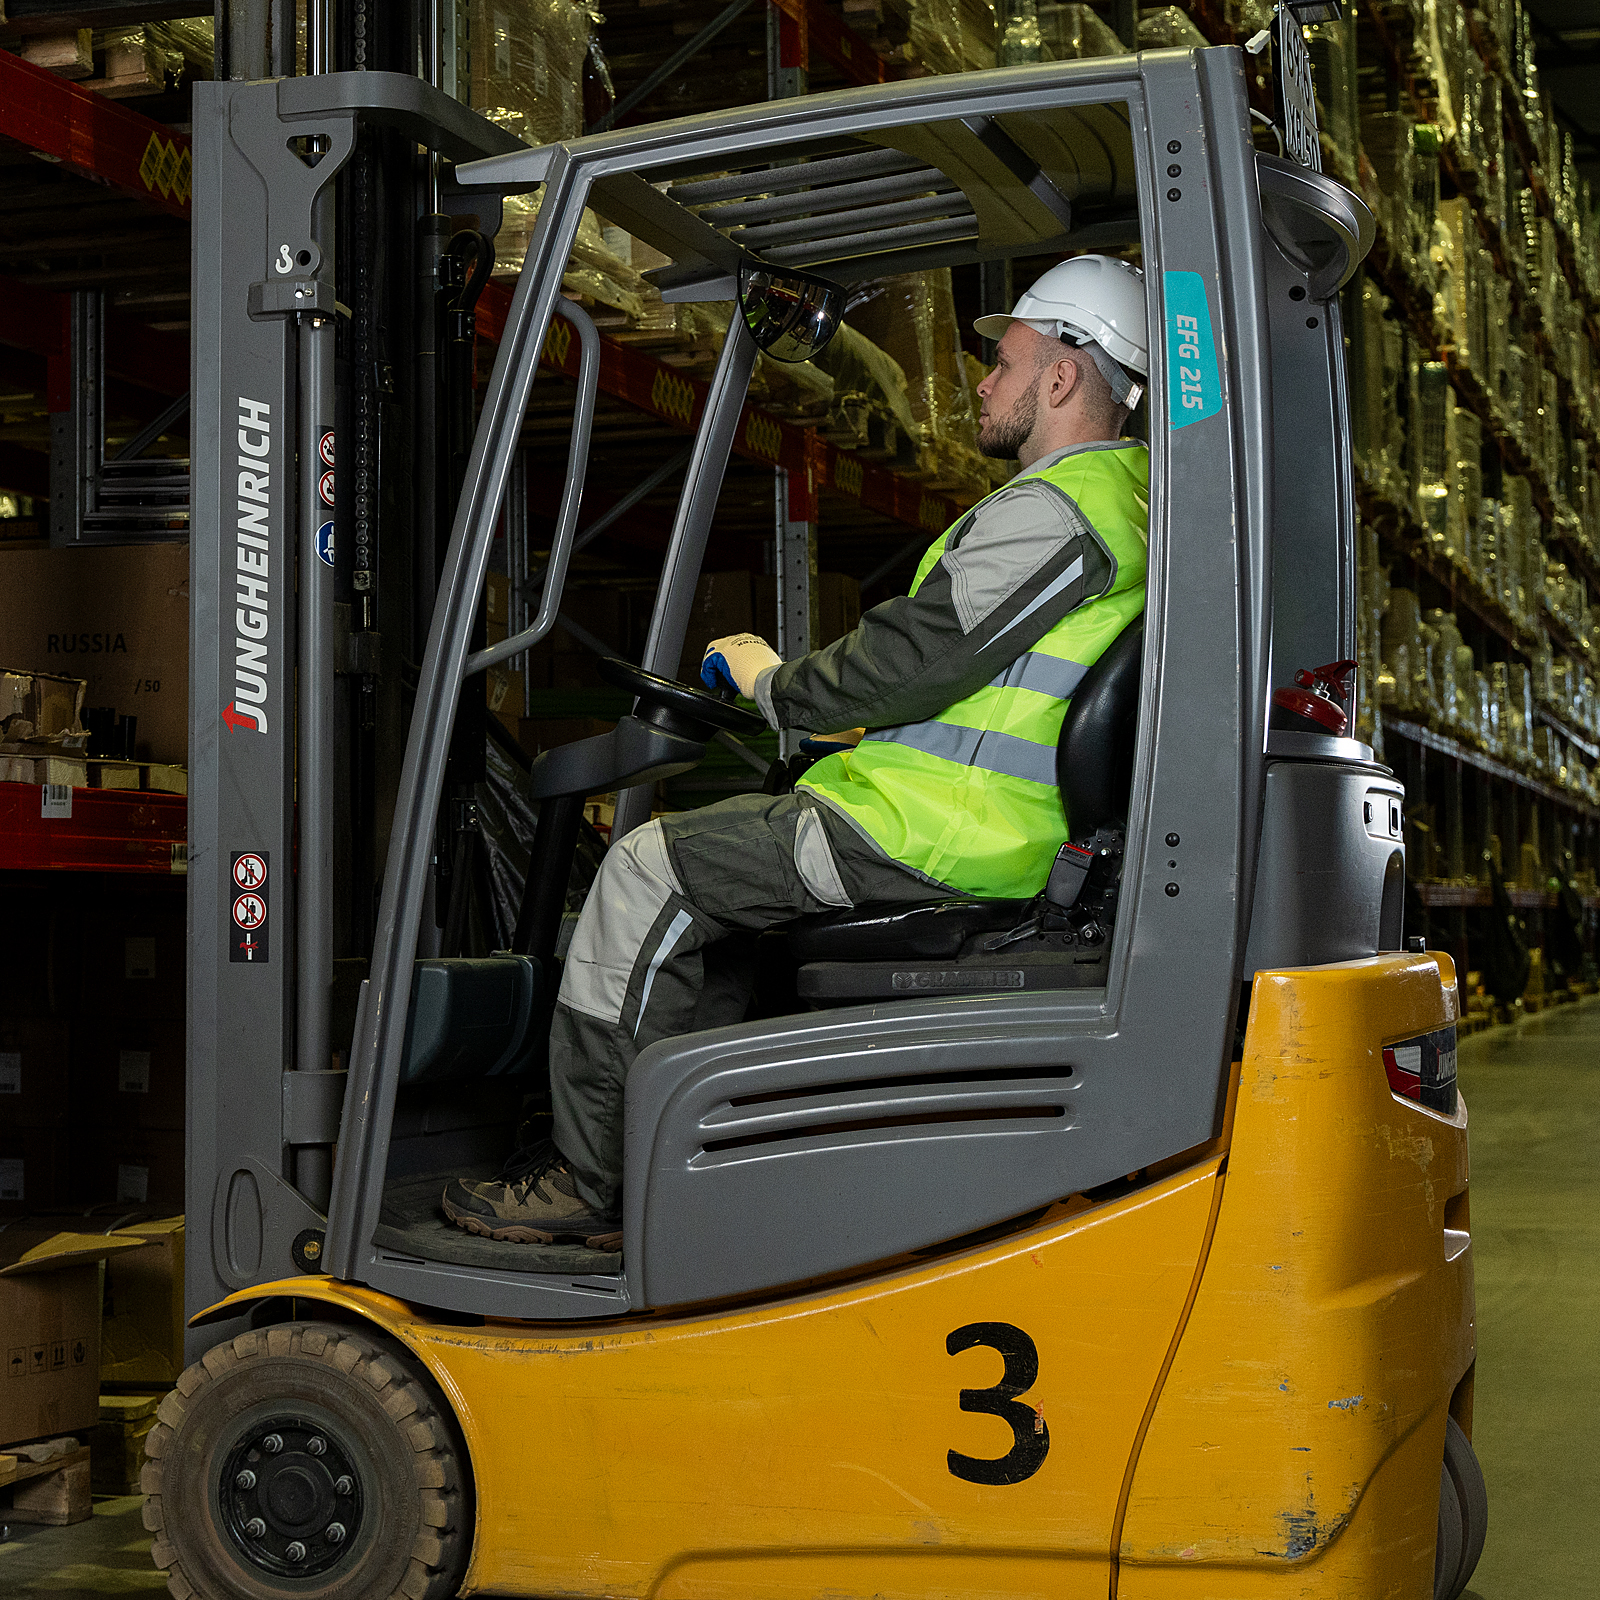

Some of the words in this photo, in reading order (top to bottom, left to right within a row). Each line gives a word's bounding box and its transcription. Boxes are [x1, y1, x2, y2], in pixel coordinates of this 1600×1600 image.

[1176, 314, 1200, 360] EFG
[1180, 366, 1204, 411] 215
[235, 396, 271, 735] JUNGHEINRICH
[46, 632, 128, 654] RUSSIA
[915, 971, 1021, 988] GRAMMER
[945, 1321, 1051, 1486] 3
